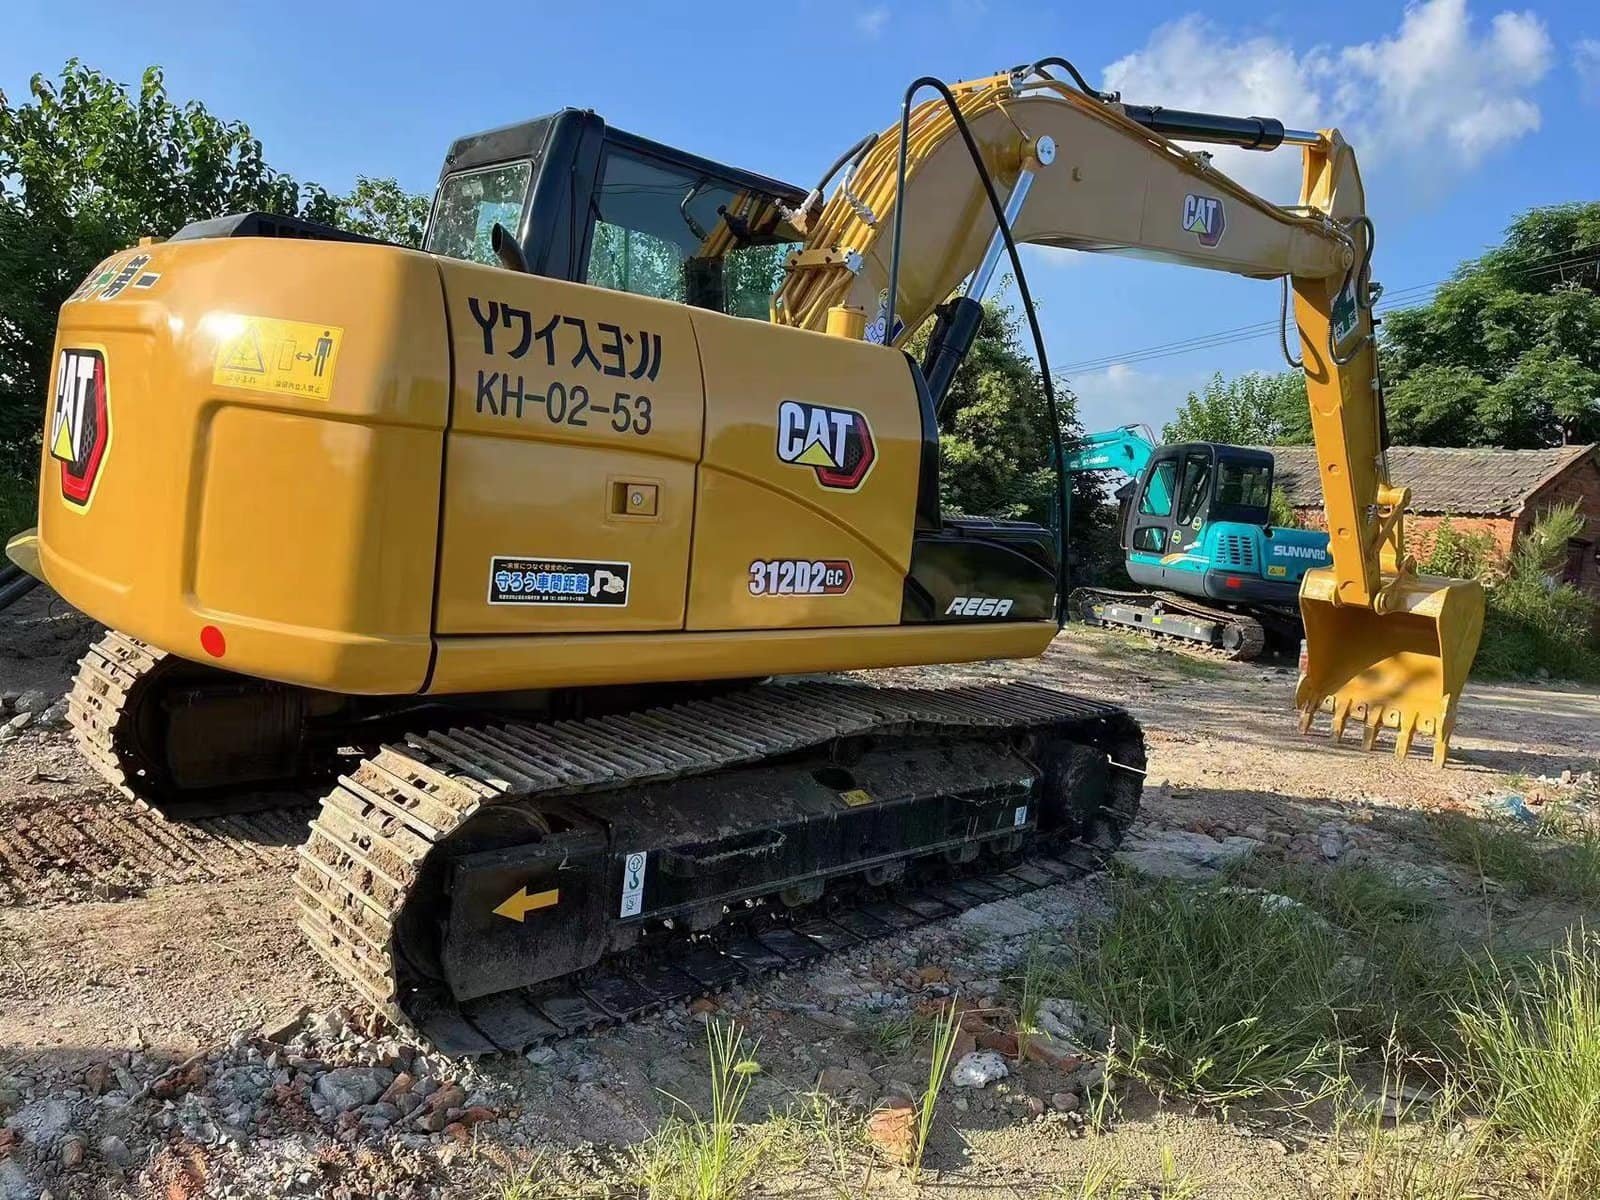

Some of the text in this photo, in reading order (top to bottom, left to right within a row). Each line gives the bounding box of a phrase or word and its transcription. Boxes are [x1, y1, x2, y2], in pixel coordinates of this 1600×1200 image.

[1183, 194, 1217, 234] CAT
[51, 350, 96, 463] CAT
[476, 370, 652, 436] KH-02-53
[778, 401, 854, 468] CAT
[1273, 545, 1326, 561] SUNWARD
[495, 570, 590, 594] 守ろう車間距離
[749, 560, 843, 595] 312D2 GC
